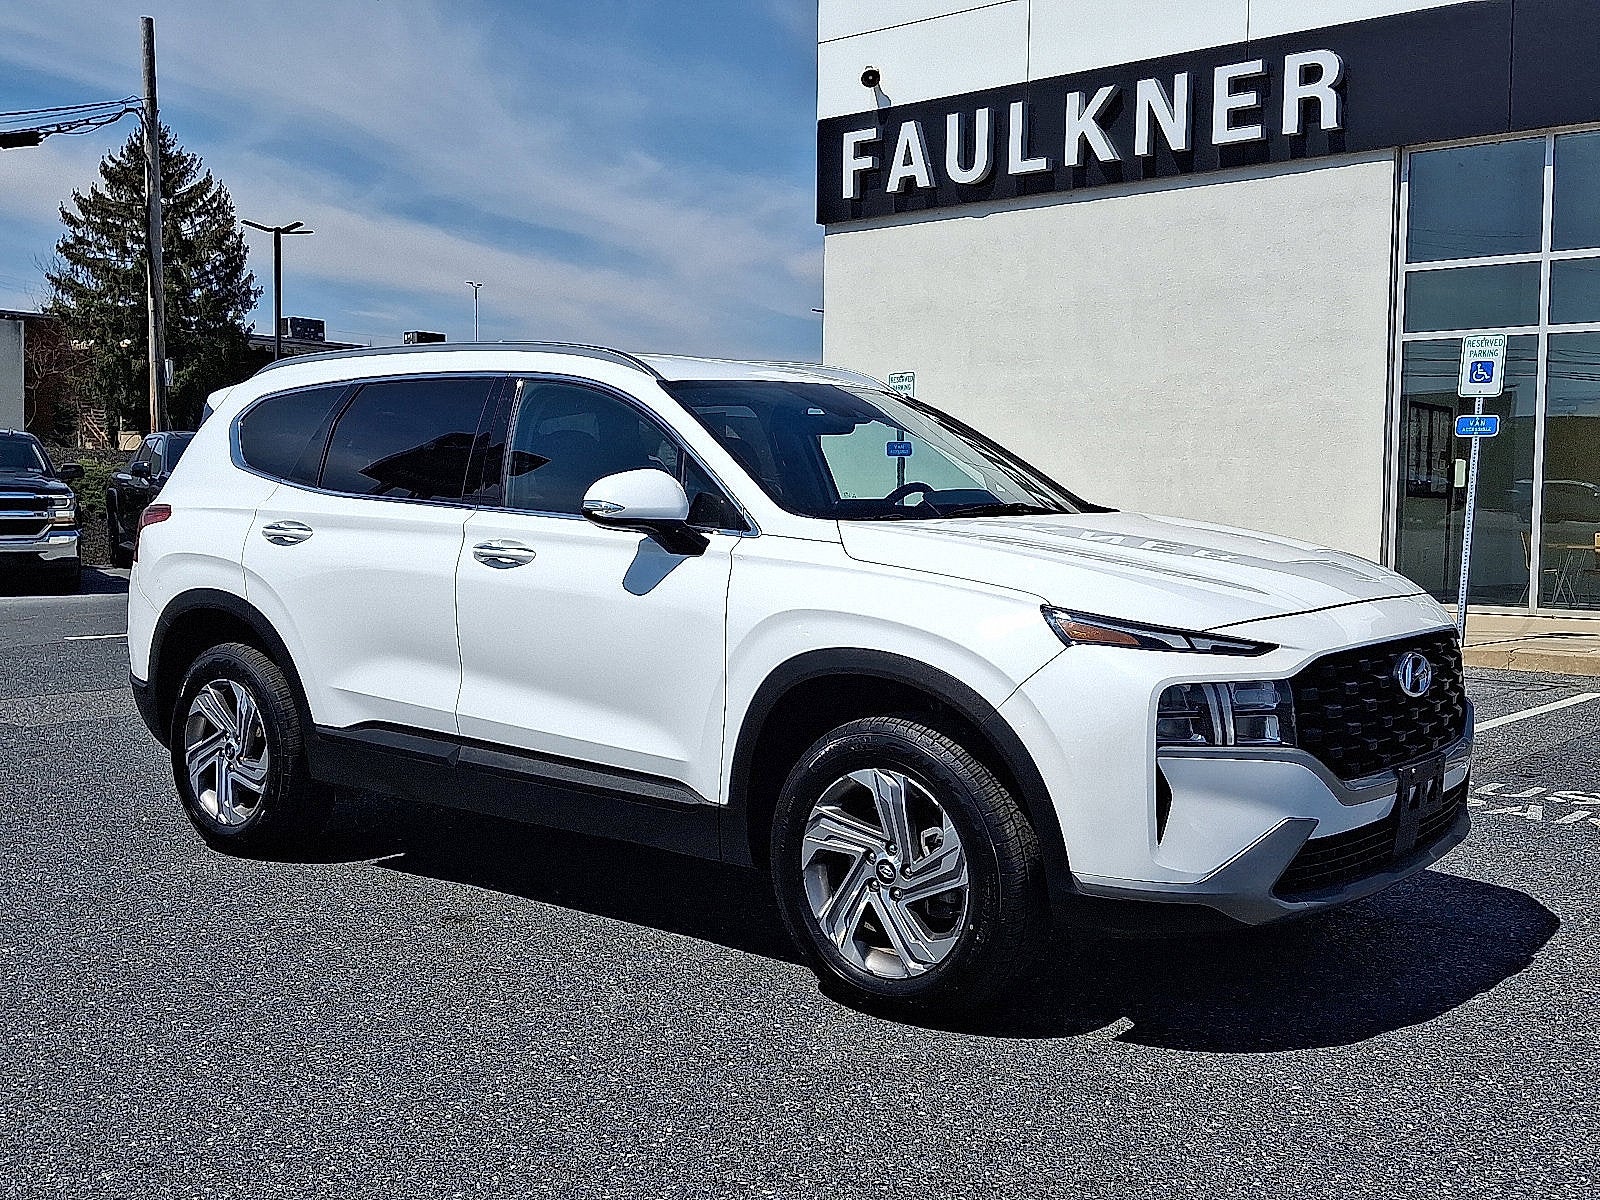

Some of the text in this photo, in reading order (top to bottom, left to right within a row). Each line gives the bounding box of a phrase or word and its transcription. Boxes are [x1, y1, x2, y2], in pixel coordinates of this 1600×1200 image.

[841, 48, 1344, 199] FAULKNER
[1466, 338, 1503, 348] RESERVED
[1469, 349, 1499, 358] PARKING
[1469, 419, 1486, 427] VAN
